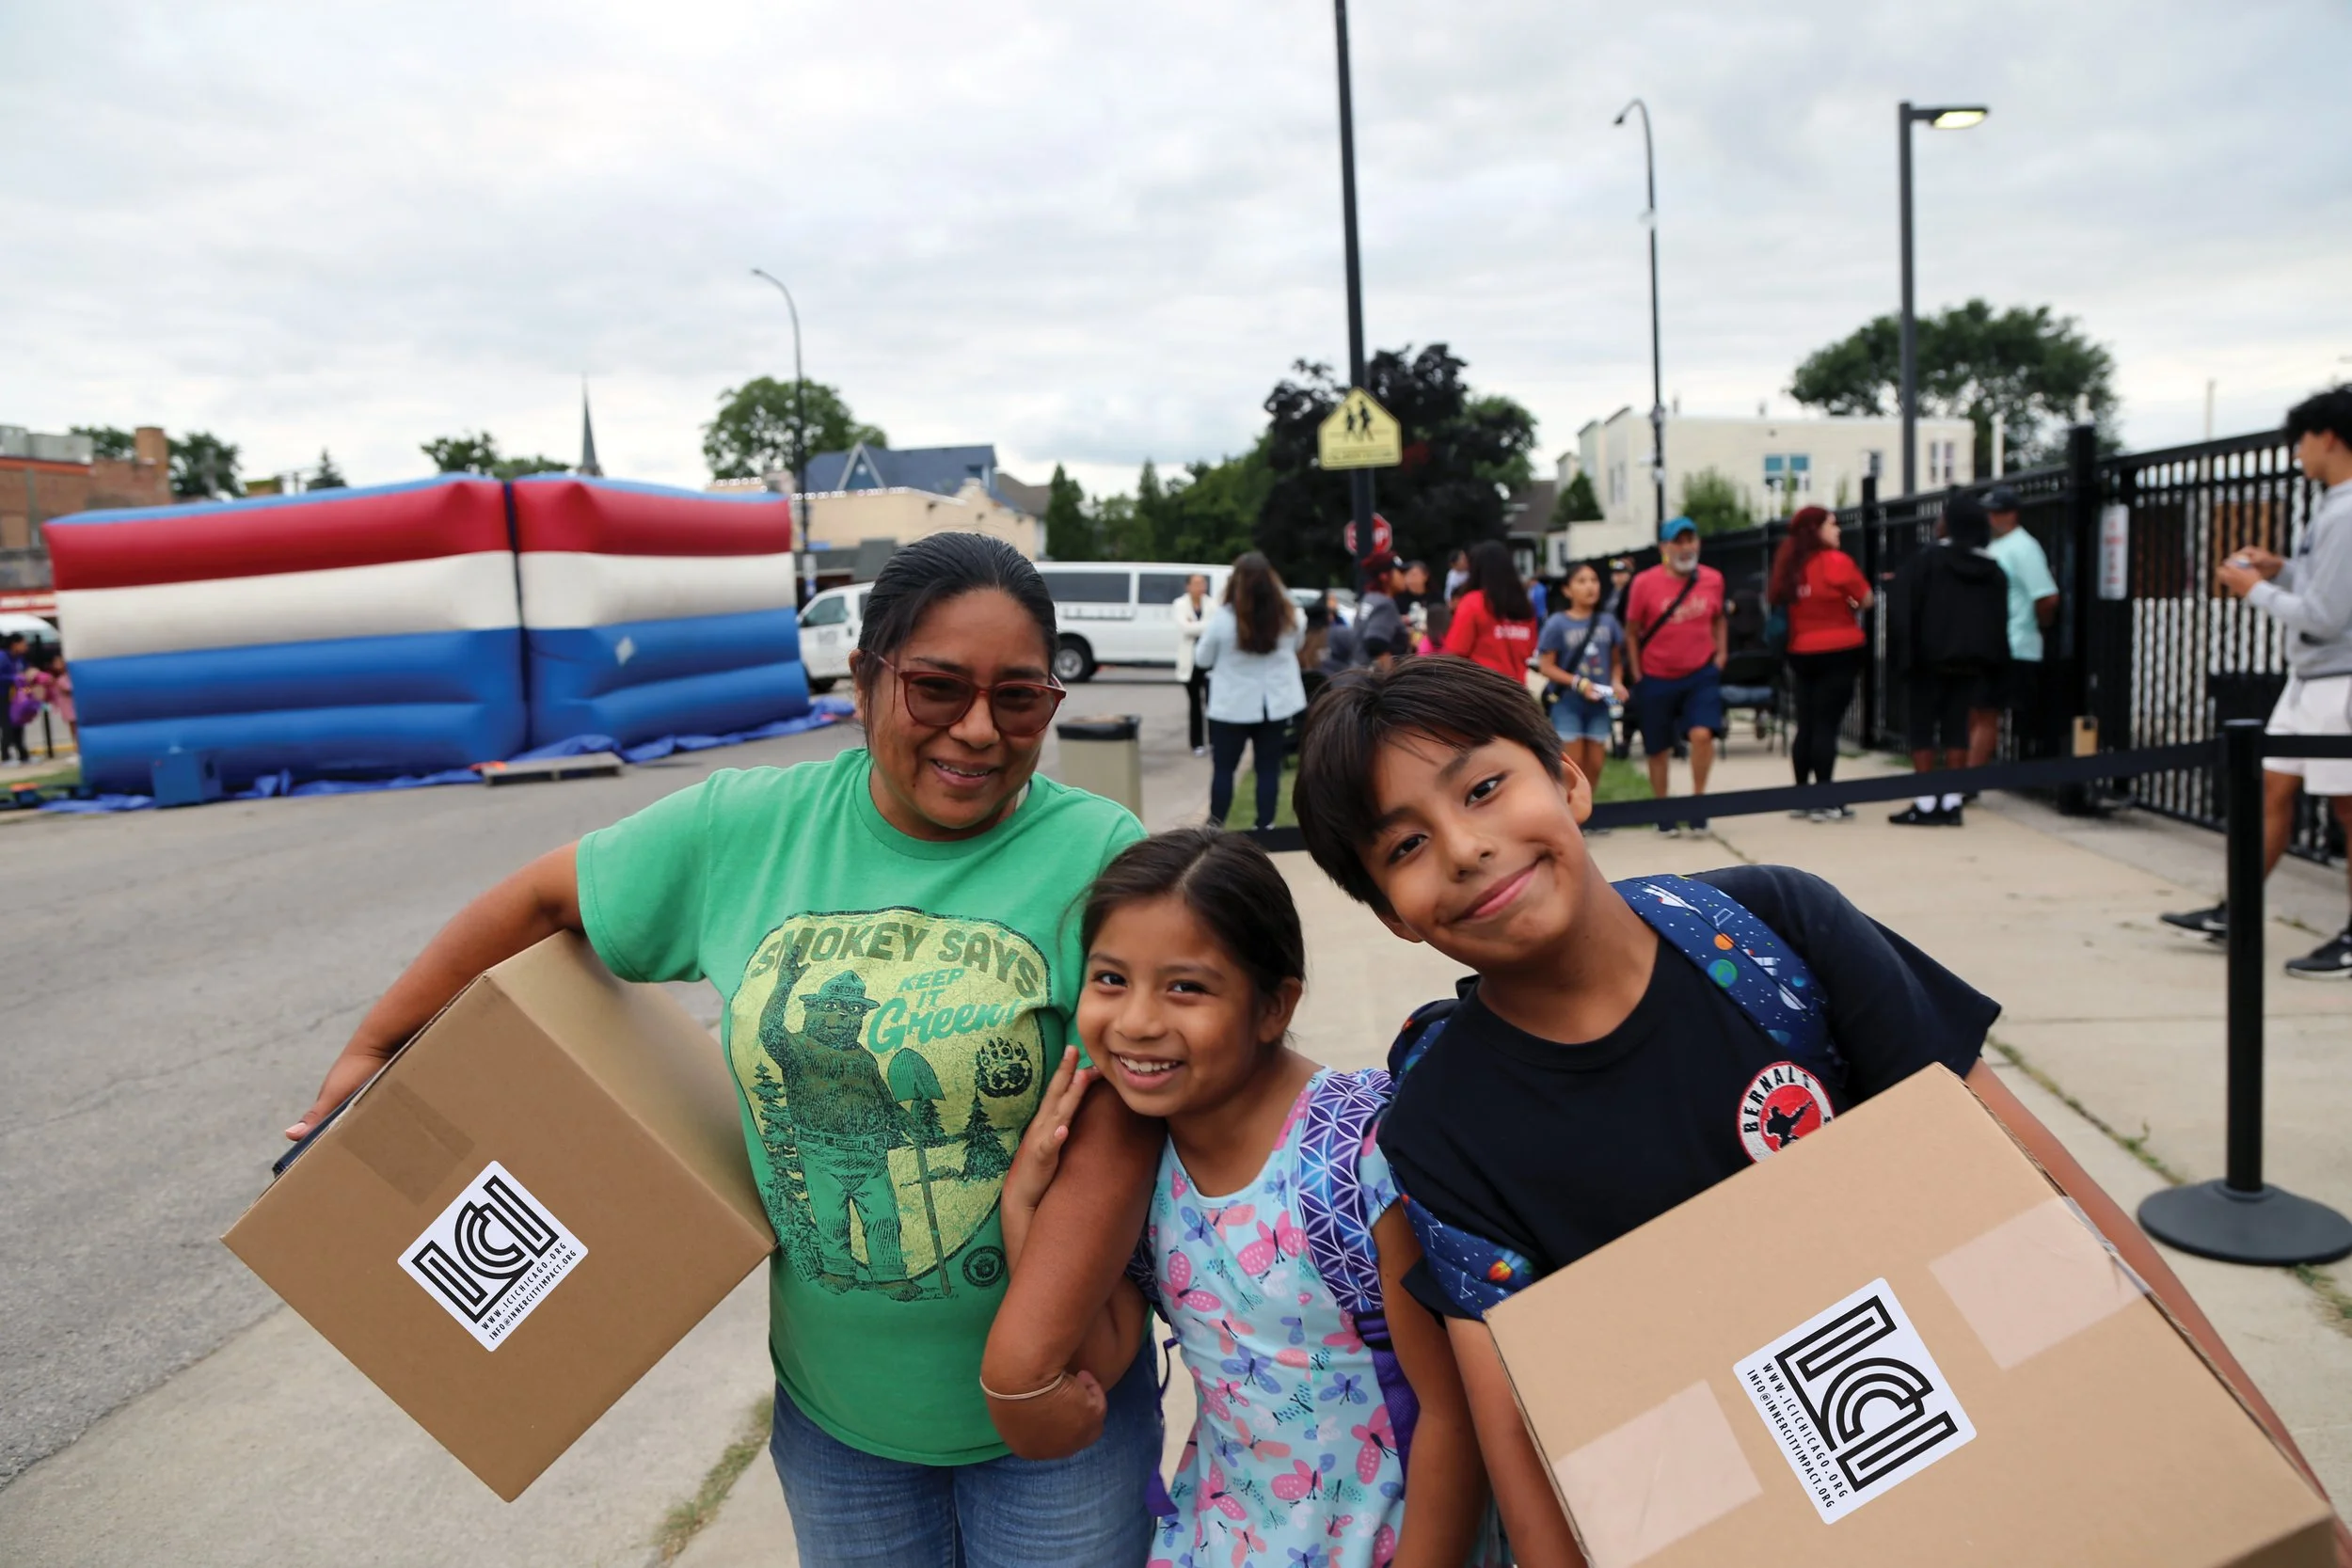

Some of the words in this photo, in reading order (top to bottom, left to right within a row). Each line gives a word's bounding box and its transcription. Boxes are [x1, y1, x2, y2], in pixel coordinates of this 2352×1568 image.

[751, 922, 930, 978] SMOKEY
[938, 929, 1039, 998] SAYS
[898, 968, 965, 992] KEEP
[916, 989, 946, 1008] IT
[481, 1242, 567, 1331] WWW.ICICHICAGO.ORG
[488, 1250, 577, 1340] INFO@INNERCITYIMPACT.ORG
[1746, 1369, 1835, 1508] INFO@INNERCITYIMPACT.ORG
[1762, 1362, 1848, 1497] WWW.ICICHICAGO.ORG
